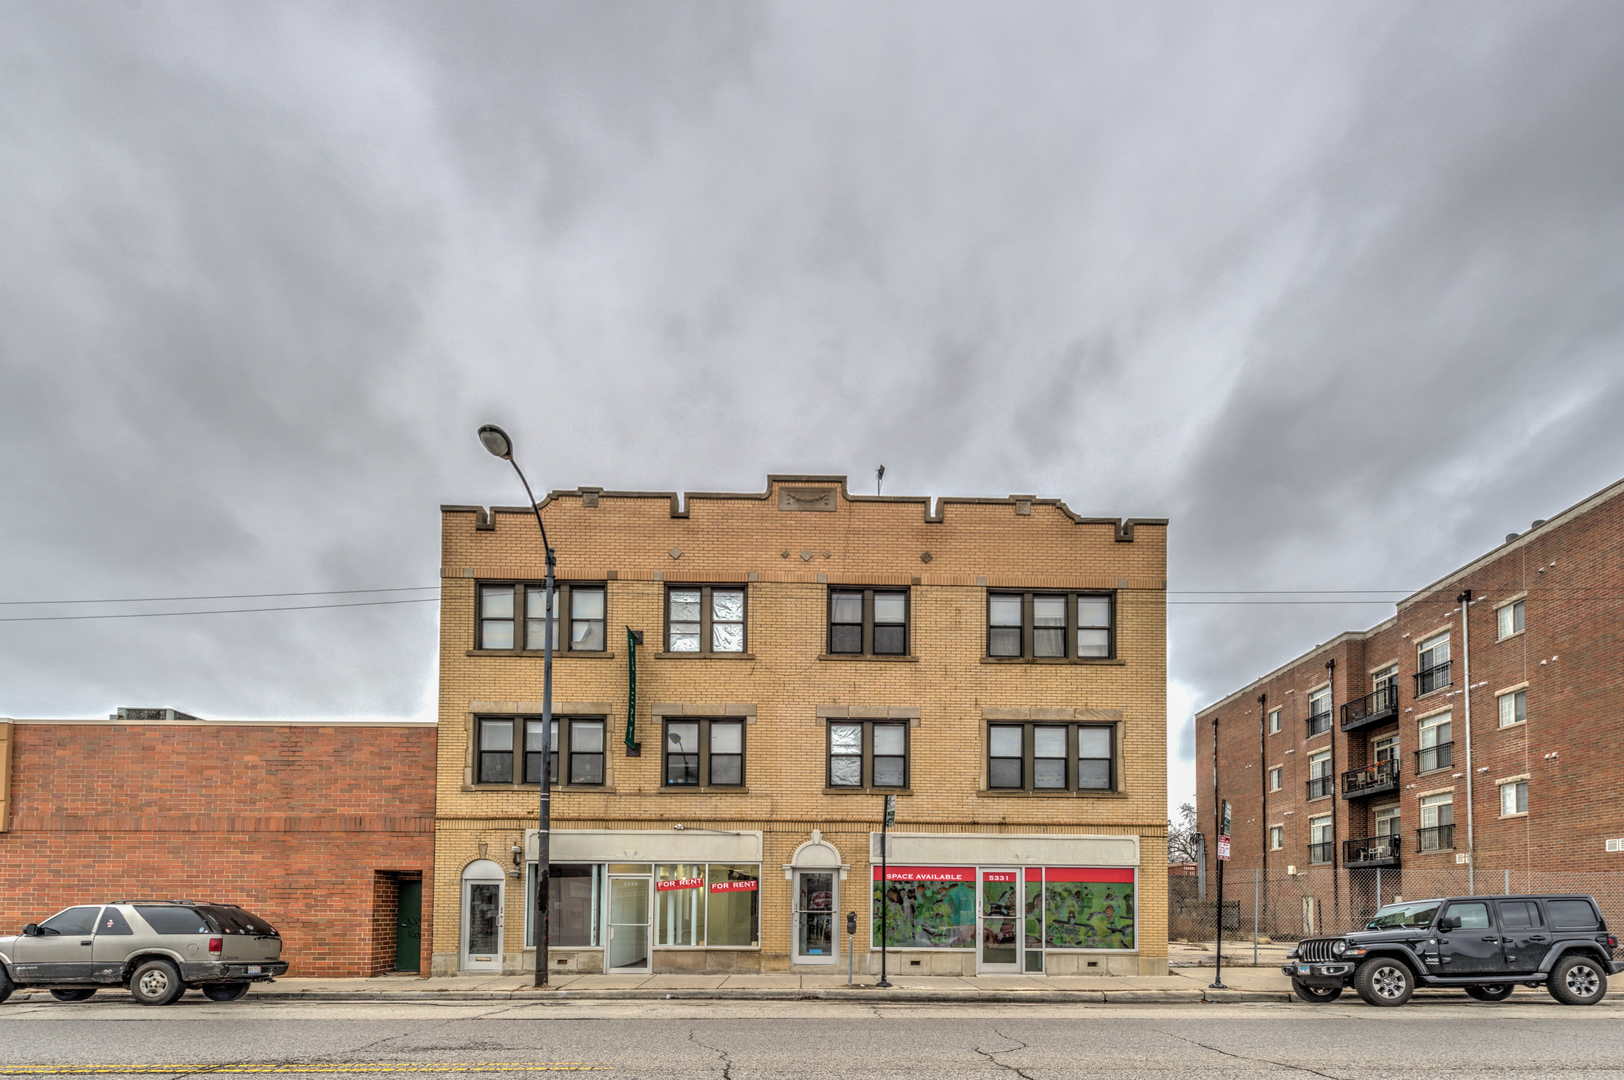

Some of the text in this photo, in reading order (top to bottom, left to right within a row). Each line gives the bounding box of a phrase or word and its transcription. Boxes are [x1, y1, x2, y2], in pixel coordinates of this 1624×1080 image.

[658, 878, 702, 888] FOR RENT
[732, 880, 756, 888] RENT
